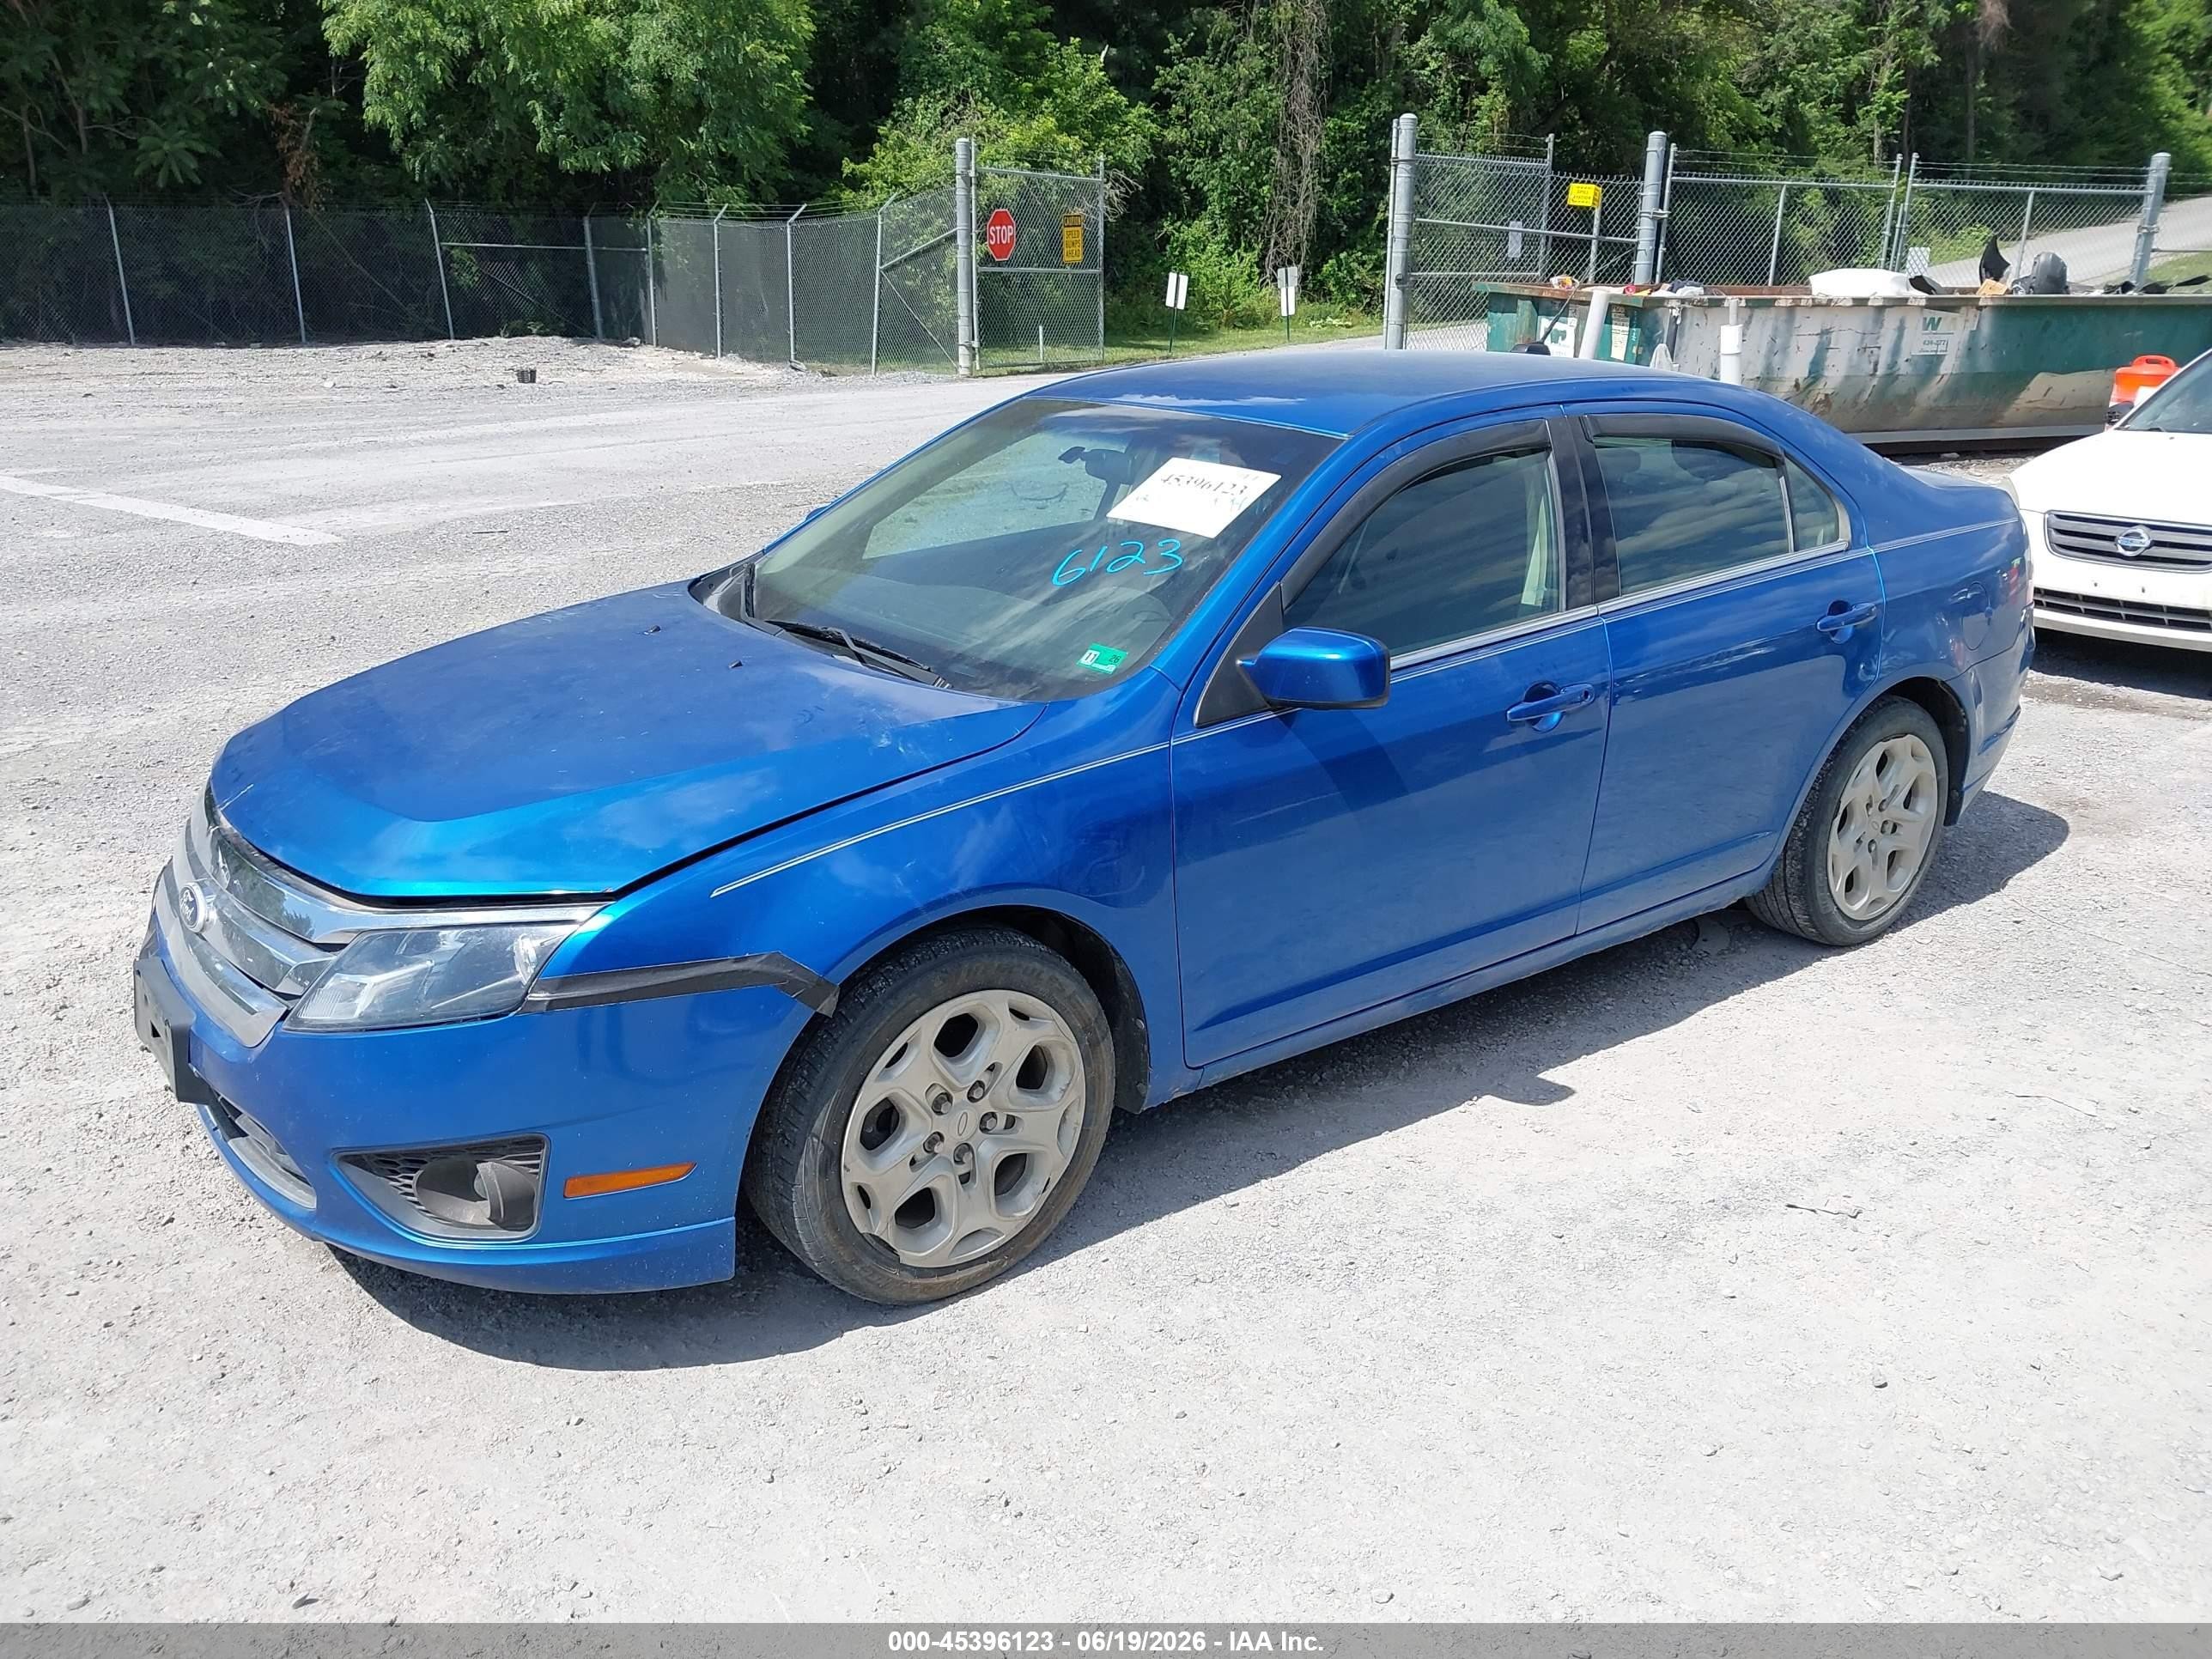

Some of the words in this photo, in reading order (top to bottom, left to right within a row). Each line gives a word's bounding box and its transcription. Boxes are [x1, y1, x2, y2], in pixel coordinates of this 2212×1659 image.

[989, 225, 1013, 245] STOP
[1066, 229, 1080, 240] SPEED
[1066, 239, 1081, 248] BUMPS
[1051, 538, 1184, 586] 6123
[1108, 653, 1121, 664] 26
